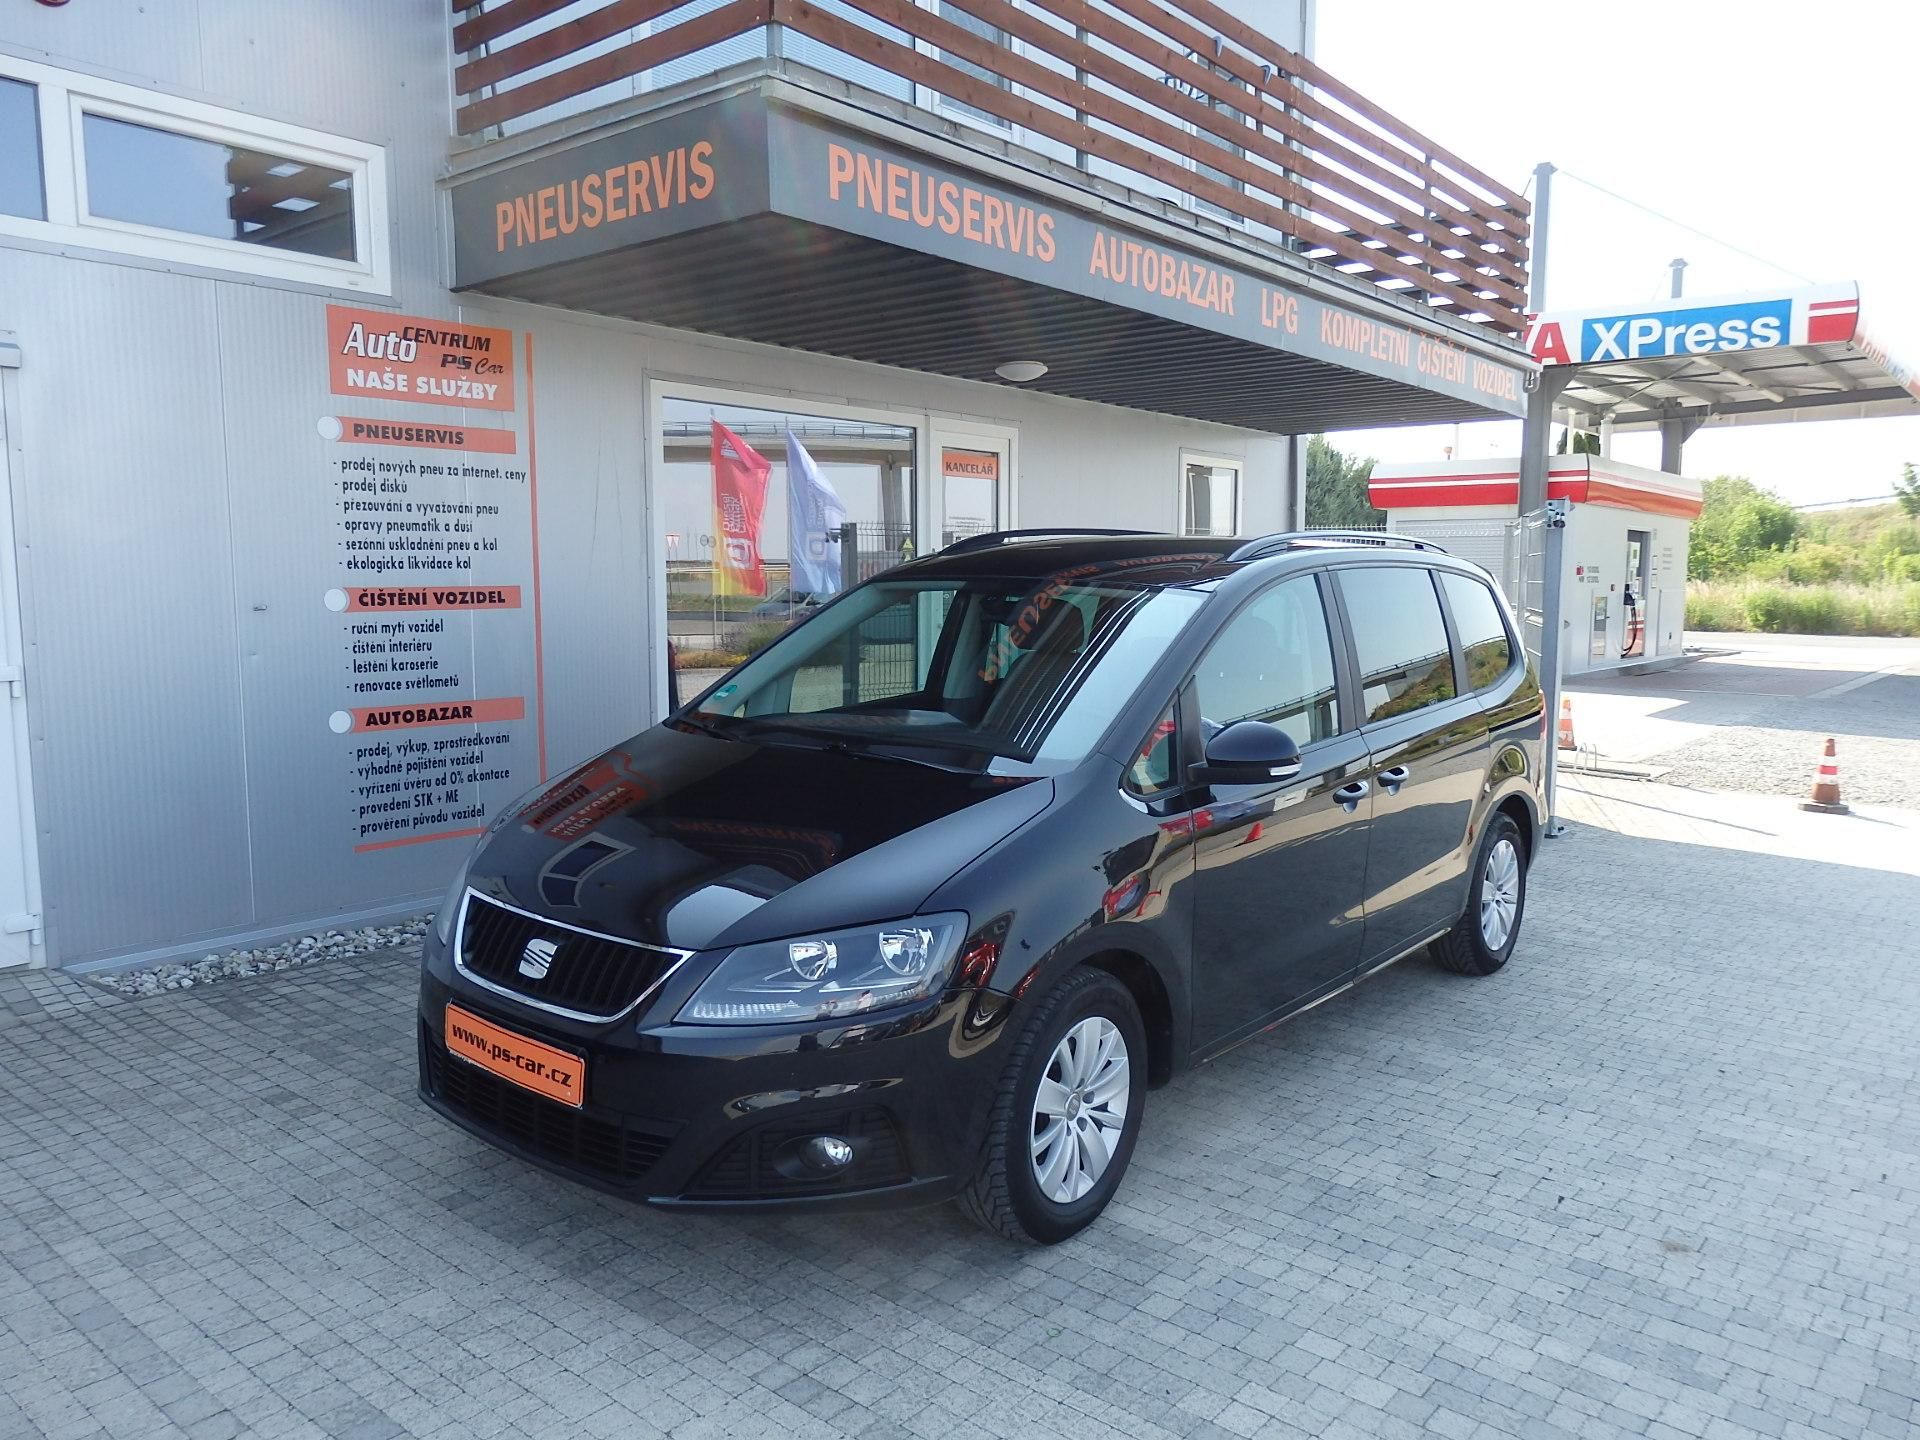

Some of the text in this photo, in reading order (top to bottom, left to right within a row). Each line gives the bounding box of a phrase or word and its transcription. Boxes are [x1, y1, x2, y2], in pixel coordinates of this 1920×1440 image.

[496, 141, 716, 253] PNEUSERVIS
[827, 142, 1056, 263] PNEUSERVIS
[1089, 231, 1235, 317] AUTOBAZAR
[1260, 288, 1298, 335] LPG
[1320, 307, 1412, 368] KOMPLETNÍ
[1472, 361, 1517, 401] VOZIDEL
[341, 322, 491, 363] Auto CENTRUM
[1589, 312, 1781, 362] XPress
[441, 353, 504, 375] PS Car
[346, 367, 498, 401] NAŠE SLUŽBY
[353, 423, 464, 445] PNEUSERVIS
[341, 457, 526, 483] prodej nových pneu za internet. ceny
[342, 477, 376, 495] prodej
[406, 503, 412, 512] a
[476, 505, 499, 517] pneu
[345, 521, 382, 534] opravy
[387, 518, 441, 534] pneumatik
[444, 523, 450, 532] a
[447, 541, 470, 553] pneu
[474, 542, 480, 551] a
[483, 538, 498, 551] kol
[347, 555, 471, 573] ekologická likvidace kol
[359, 587, 505, 606] ČIŠTĚNÍ VOZIDEL
[351, 621, 377, 634] ruční
[408, 619, 444, 633] vozidel
[391, 656, 439, 671] karoserie
[354, 680, 402, 693] renovace
[365, 705, 473, 726] AUTOBAZAR
[357, 742, 392, 761] prodej,
[450, 751, 483, 766] vozidel
[435, 772, 446, 786] od
[450, 771, 464, 785] 0%
[467, 769, 510, 783] akontace
[414, 793, 433, 807] STK
[446, 790, 459, 803] ME
[451, 804, 485, 820] vozidel
[452, 1023, 572, 1088] www.ps-car.cz
